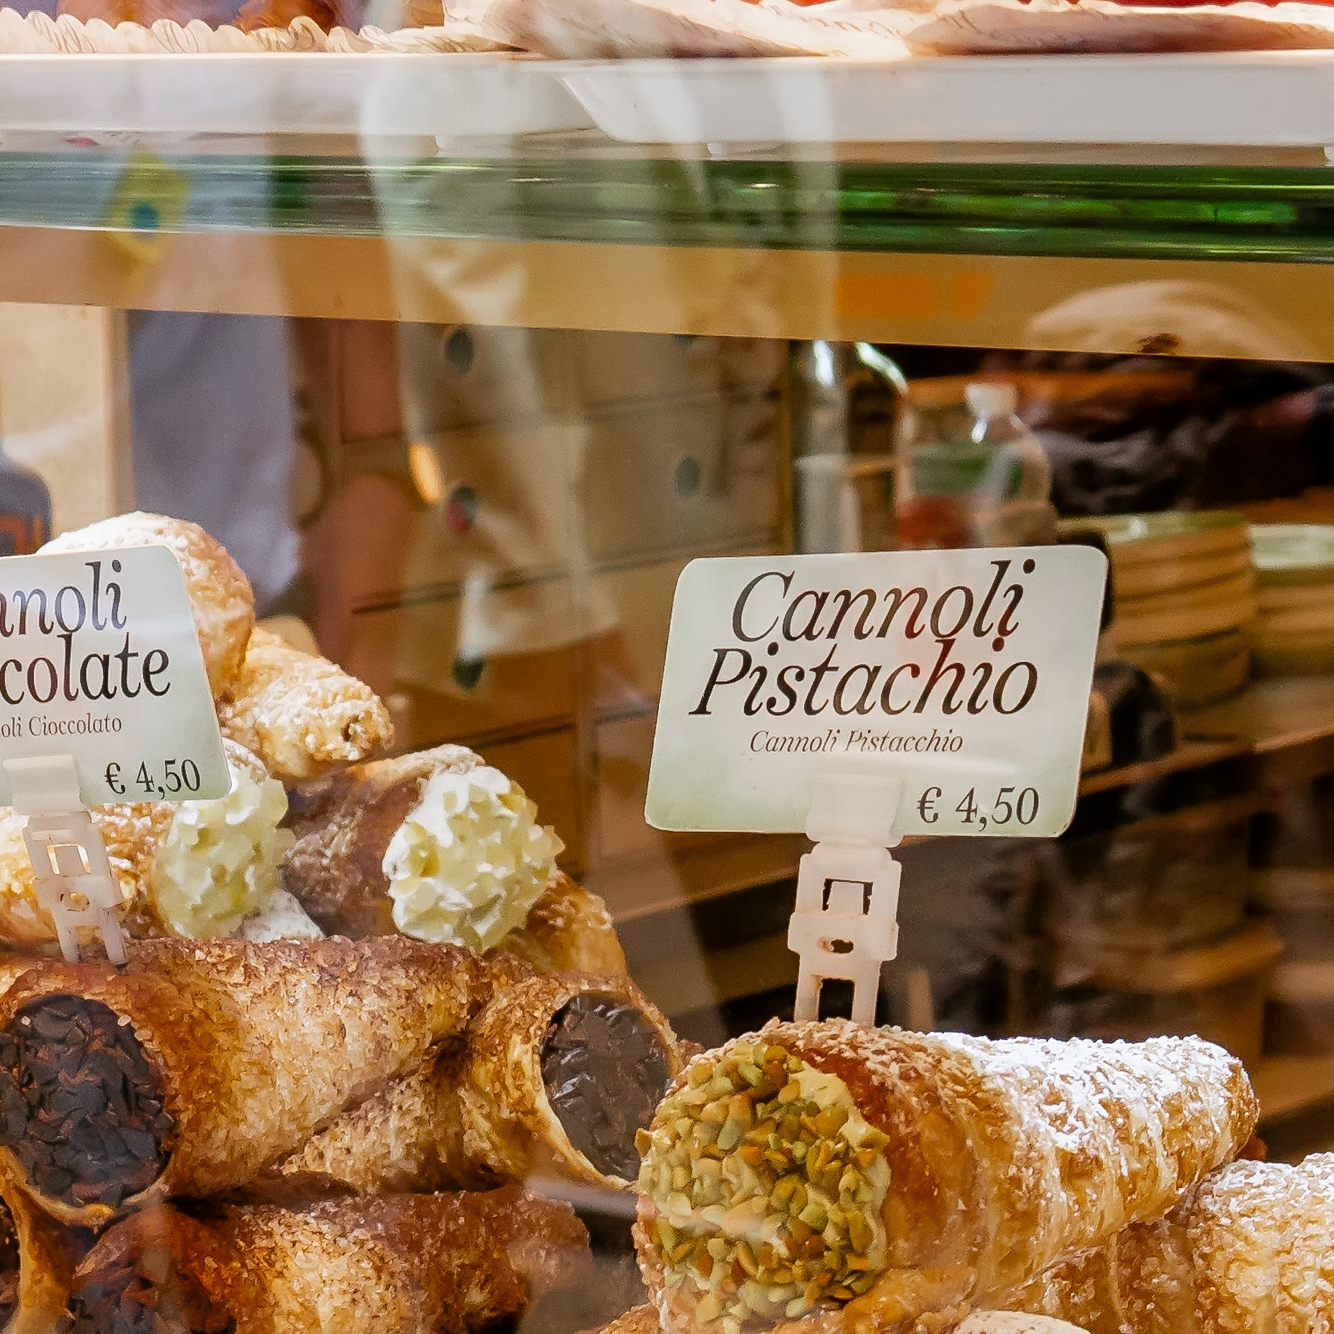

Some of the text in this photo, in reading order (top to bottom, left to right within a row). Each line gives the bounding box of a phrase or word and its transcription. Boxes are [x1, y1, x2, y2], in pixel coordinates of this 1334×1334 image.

[731, 558, 1036, 643] Cannoli
[687, 635, 1039, 717] Pistachio
[28, 711, 123, 738] Cioccolato
[749, 728, 964, 754] Cannoli Pistacchio
[103, 757, 202, 801] € 4,50
[916, 785, 1041, 833] € 4,50
